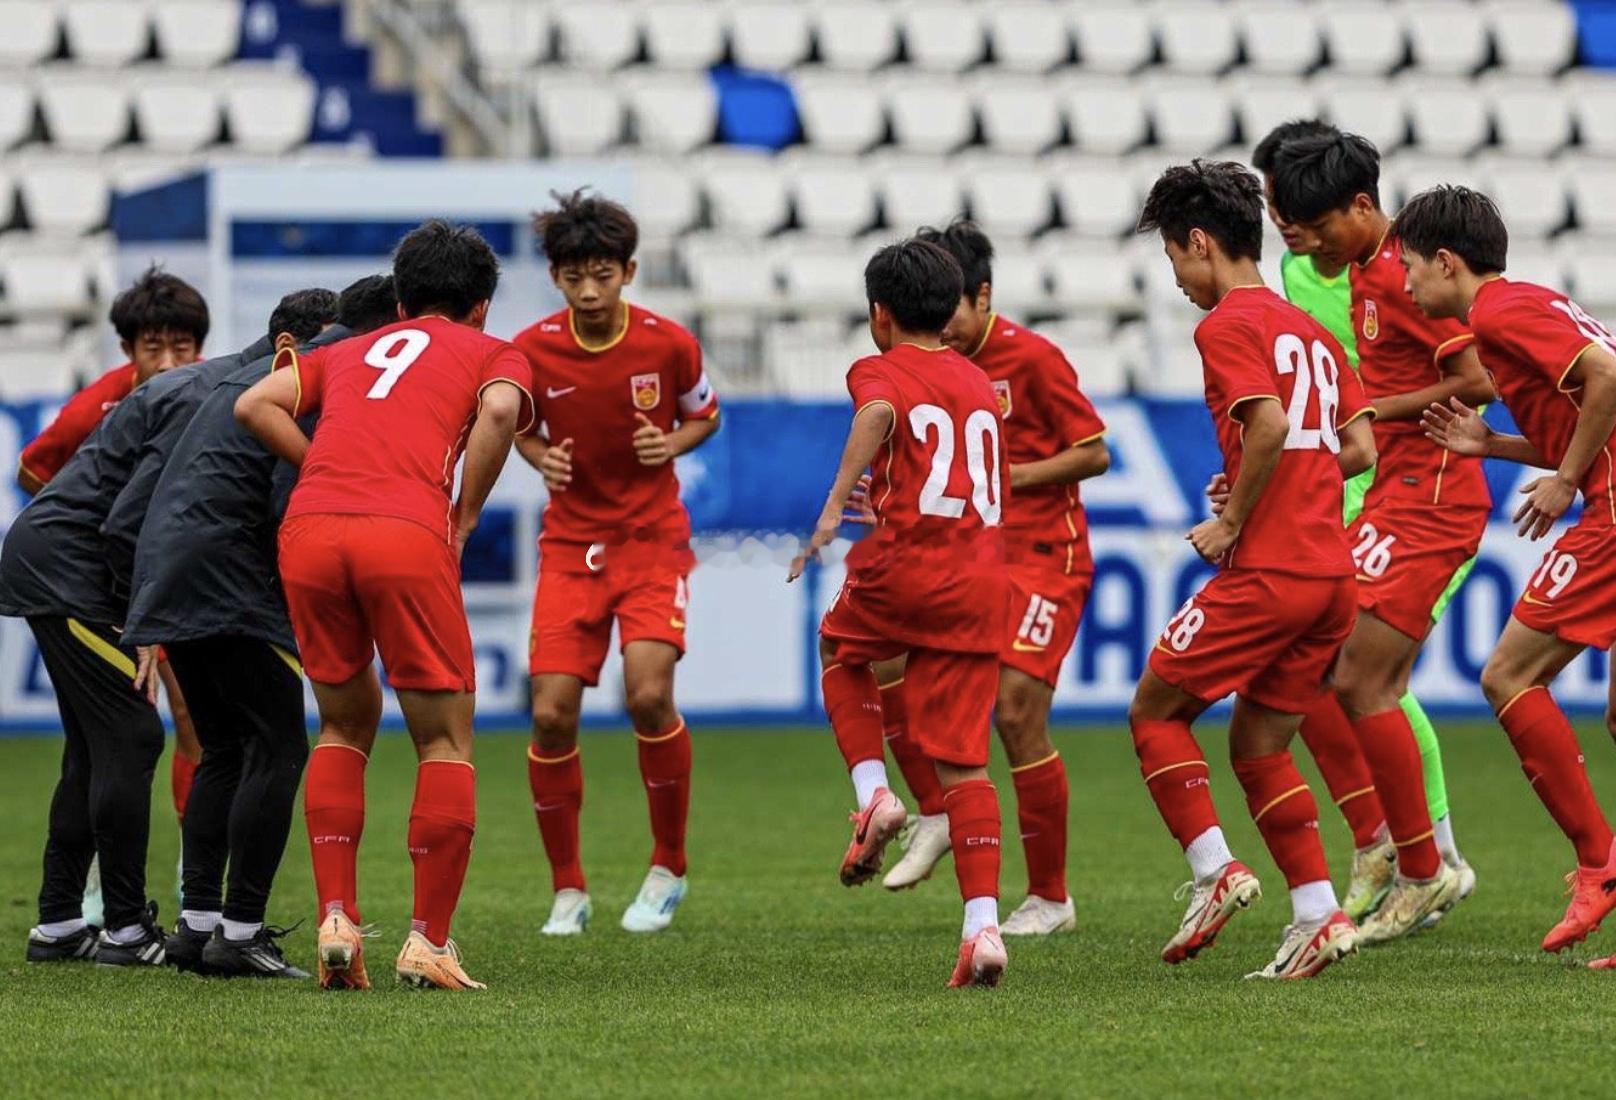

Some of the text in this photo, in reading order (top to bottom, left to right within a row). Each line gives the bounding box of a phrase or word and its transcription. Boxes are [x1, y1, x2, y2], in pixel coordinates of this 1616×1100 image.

[363, 328, 431, 399] 9
[1273, 332, 1341, 454] 28
[908, 403, 1001, 527] 20
[1351, 521, 1397, 577] 26
[1532, 549, 1578, 599] 19
[1017, 592, 1058, 647] 15
